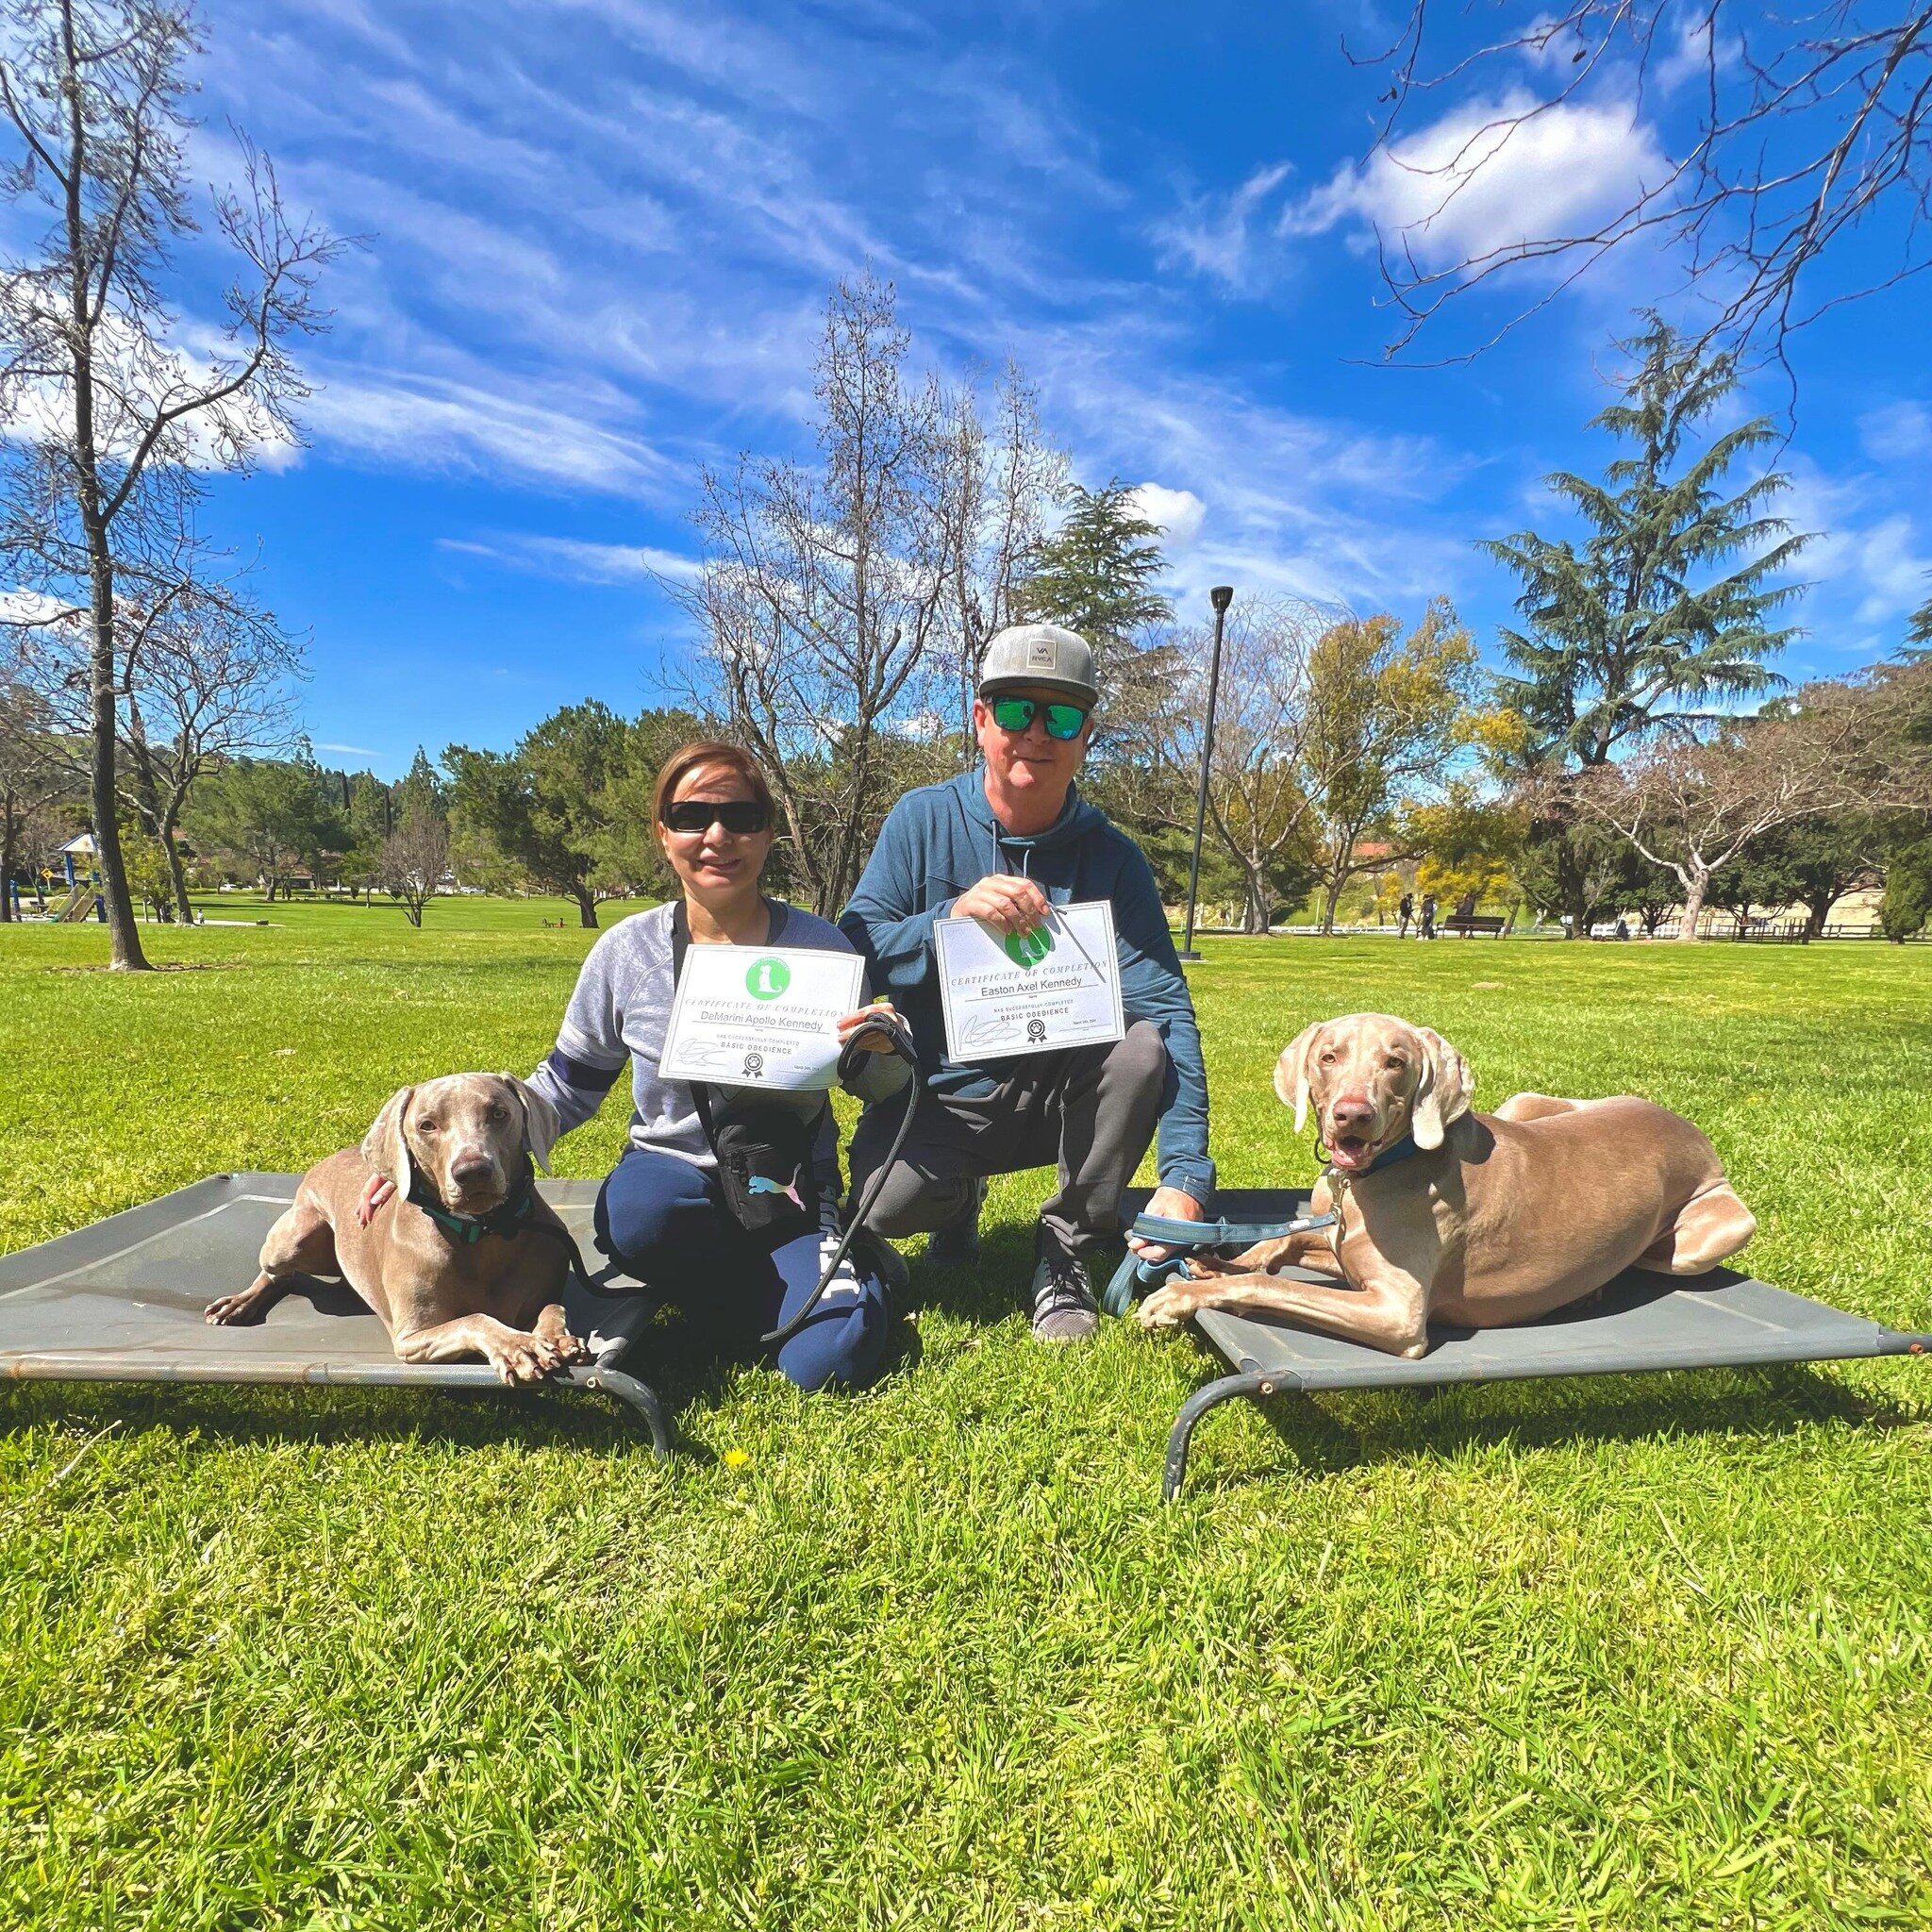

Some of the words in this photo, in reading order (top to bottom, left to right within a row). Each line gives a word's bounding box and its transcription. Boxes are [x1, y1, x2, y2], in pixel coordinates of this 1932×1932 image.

[951, 971, 1020, 987] CERTIFICATE
[1025, 970, 1039, 978] OF
[981, 985, 1015, 997] Easton
[1017, 983, 1038, 992] Axel
[1041, 976, 1082, 990] Kennedy
[685, 998, 752, 1009] CERTIFICATE
[758, 1003, 774, 1011] OF
[701, 1011, 744, 1023] DeMarini
[745, 1014, 775, 1028] Apollo
[779, 1018, 824, 1032] Kennedy
[1001, 1013, 1024, 1022] BASIC
[1025, 1008, 1069, 1019] OBEDIENCE
[747, 1044, 791, 1055] OBEDIENCE
